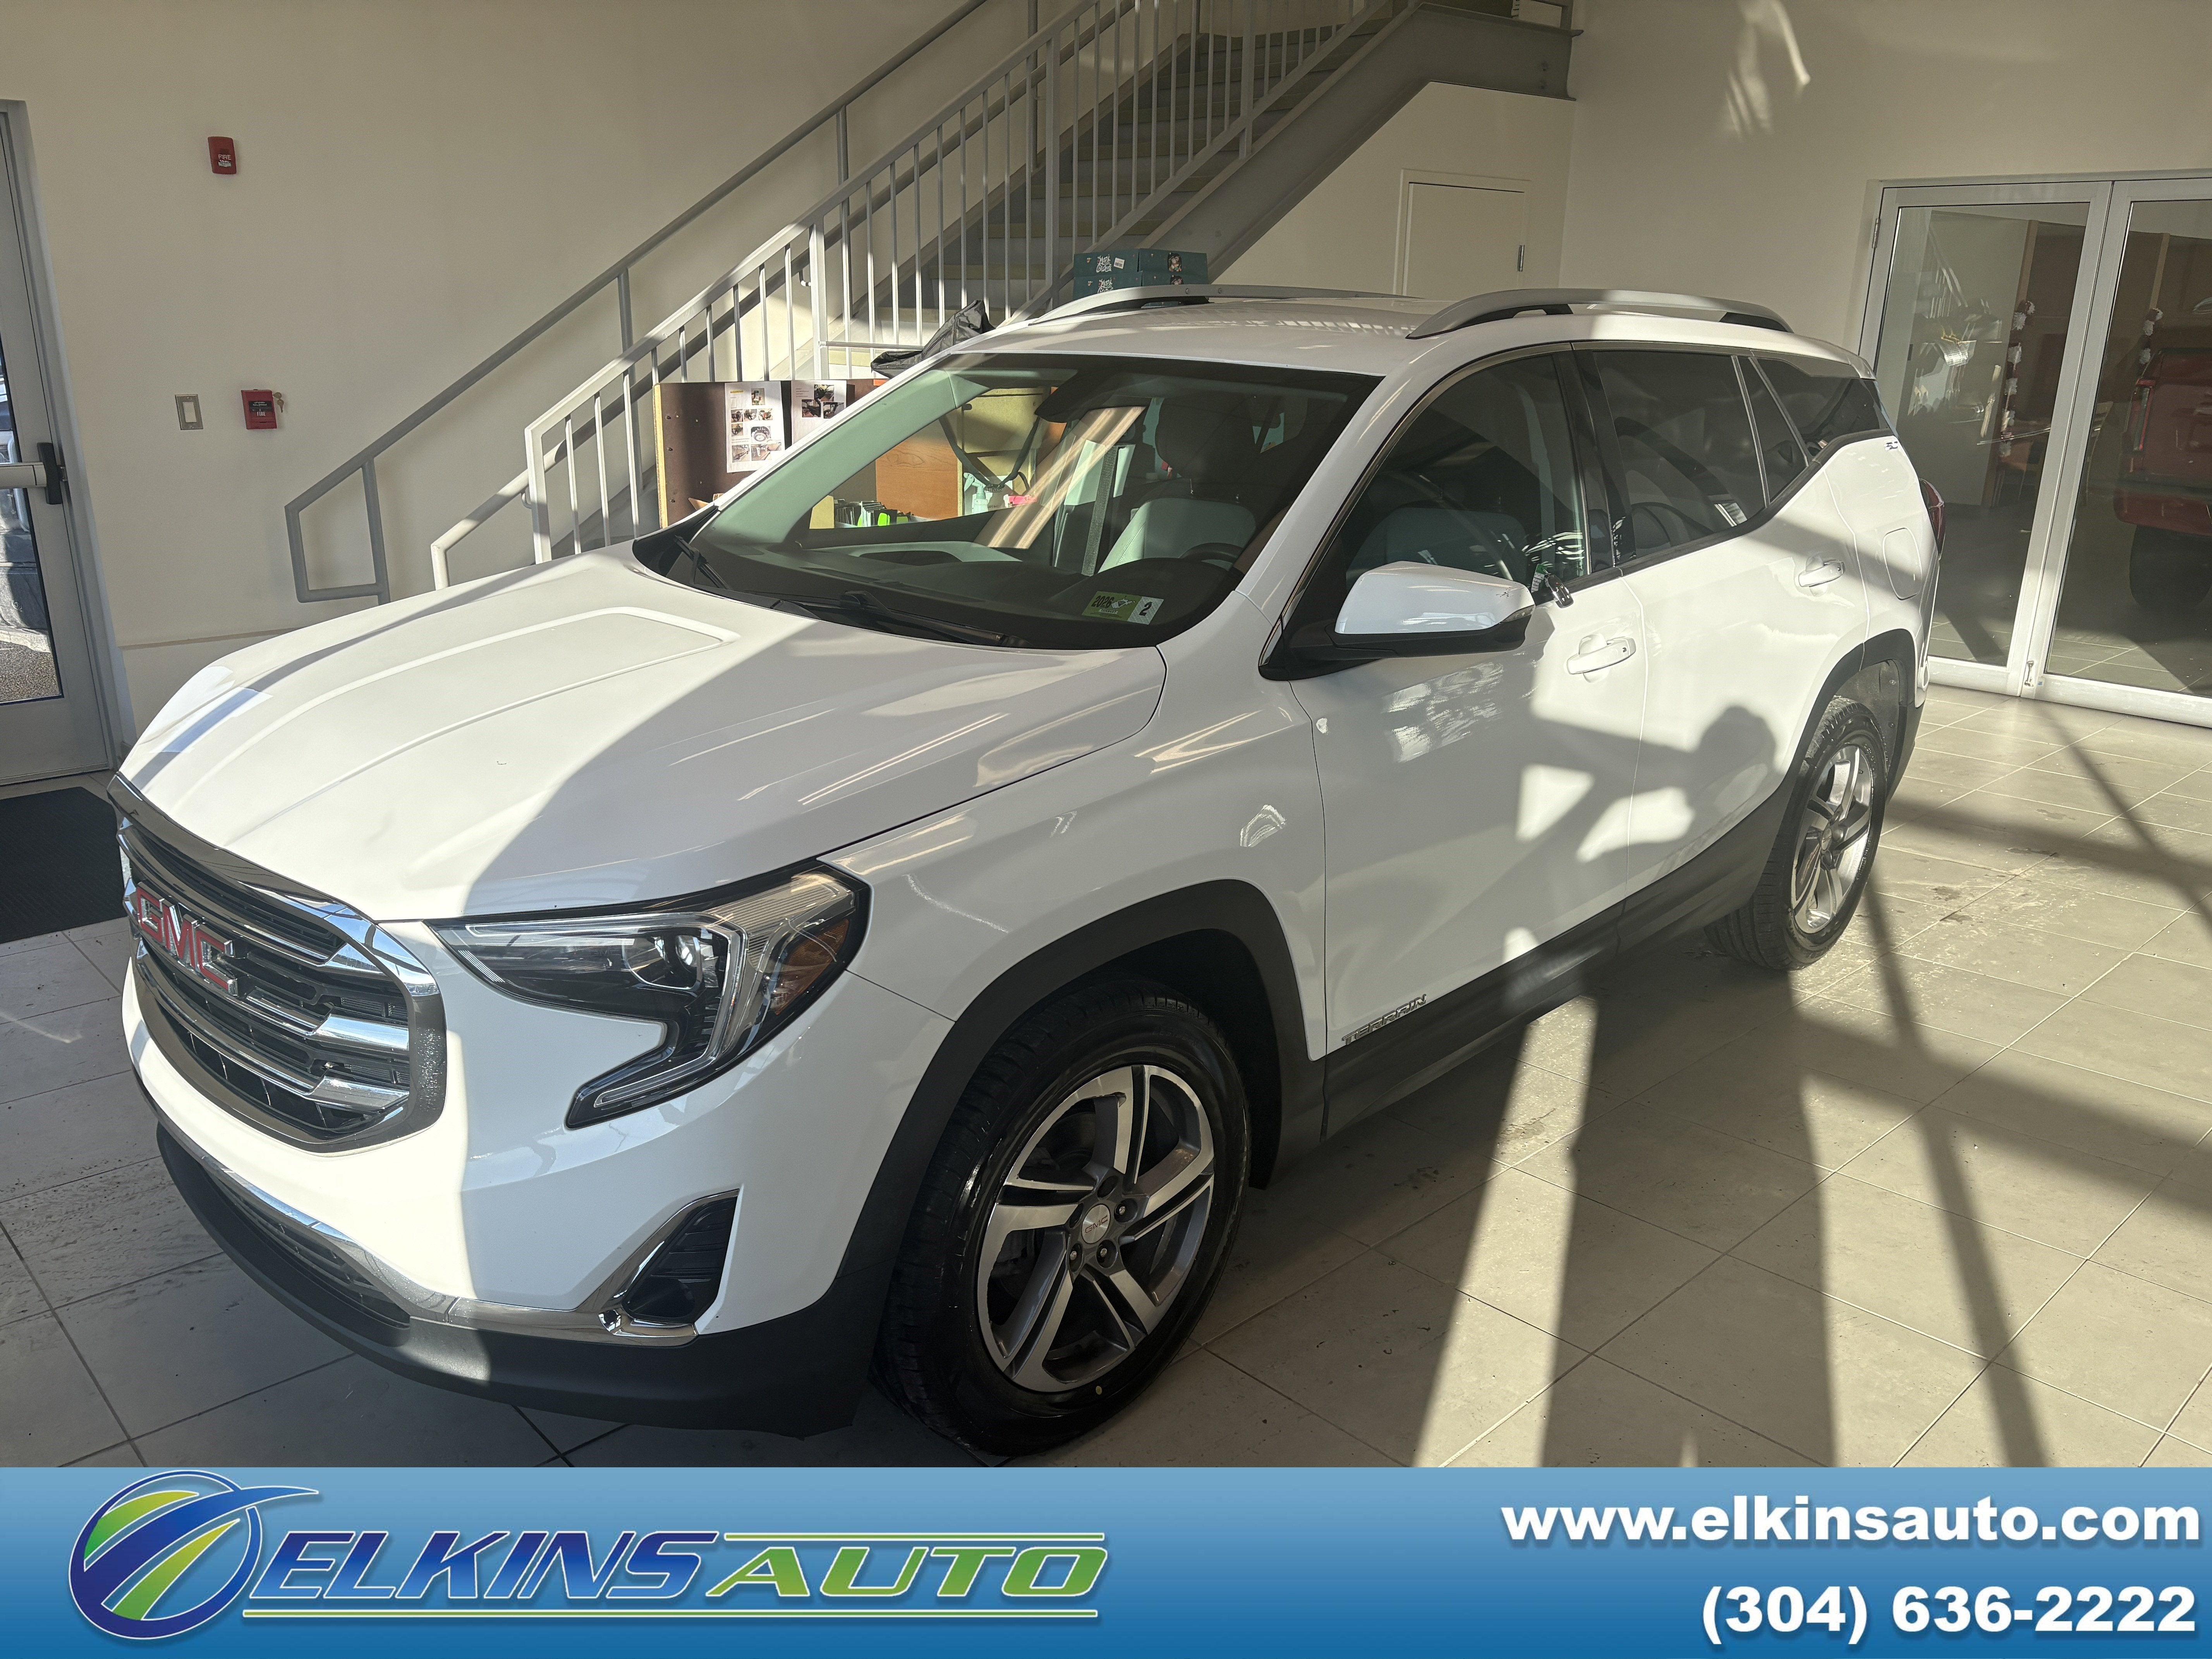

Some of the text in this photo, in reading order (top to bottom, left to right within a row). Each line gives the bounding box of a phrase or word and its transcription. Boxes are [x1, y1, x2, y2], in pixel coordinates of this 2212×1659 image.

[1091, 595, 1115, 608] 2026
[1139, 601, 1153, 616] 2
[137, 881, 239, 996] GMC
[1341, 993, 1427, 1045] TERRAIN
[1084, 1214, 1108, 1234] GMC
